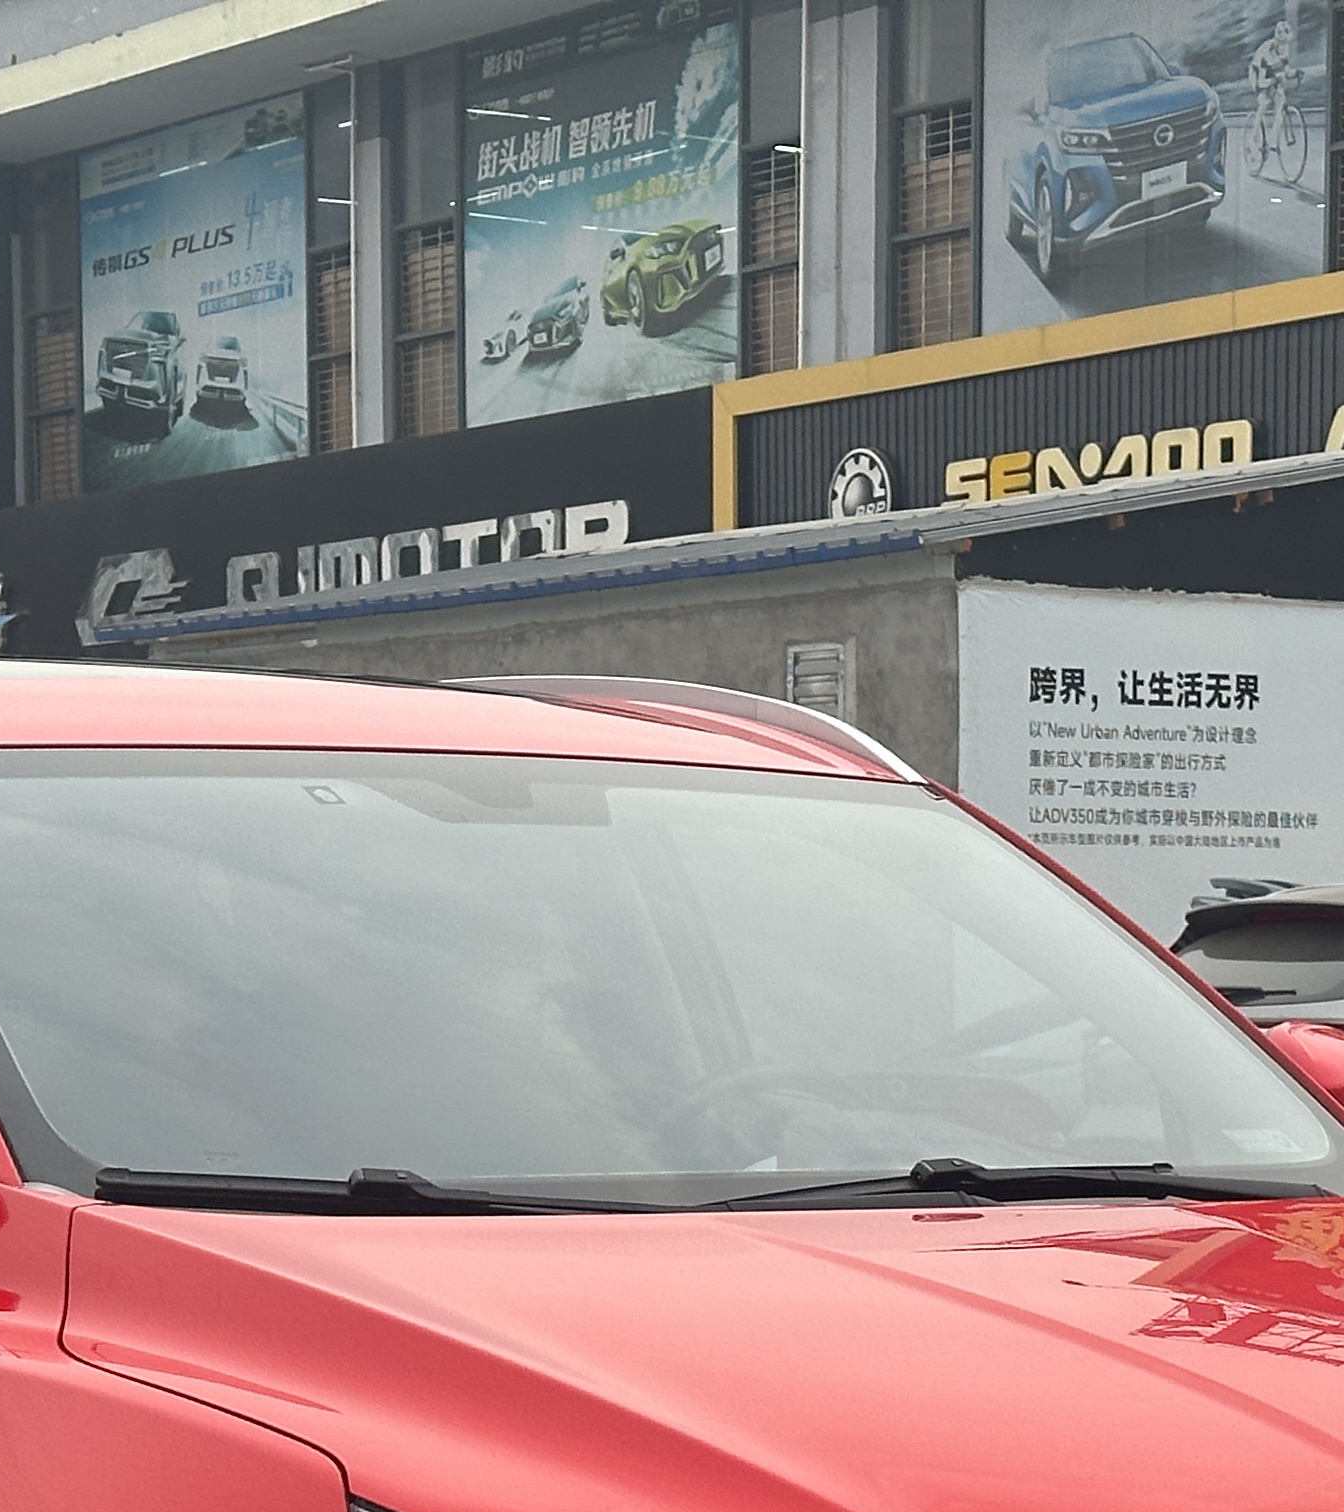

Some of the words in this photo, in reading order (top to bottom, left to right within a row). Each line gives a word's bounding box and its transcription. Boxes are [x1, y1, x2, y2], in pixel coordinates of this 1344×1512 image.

[477, 124, 563, 182] 街头战机
[171, 224, 236, 258] PLUS
[1029, 667, 1260, 711] 跨界，让生活无界
[1080, 724, 1119, 741] Urban
